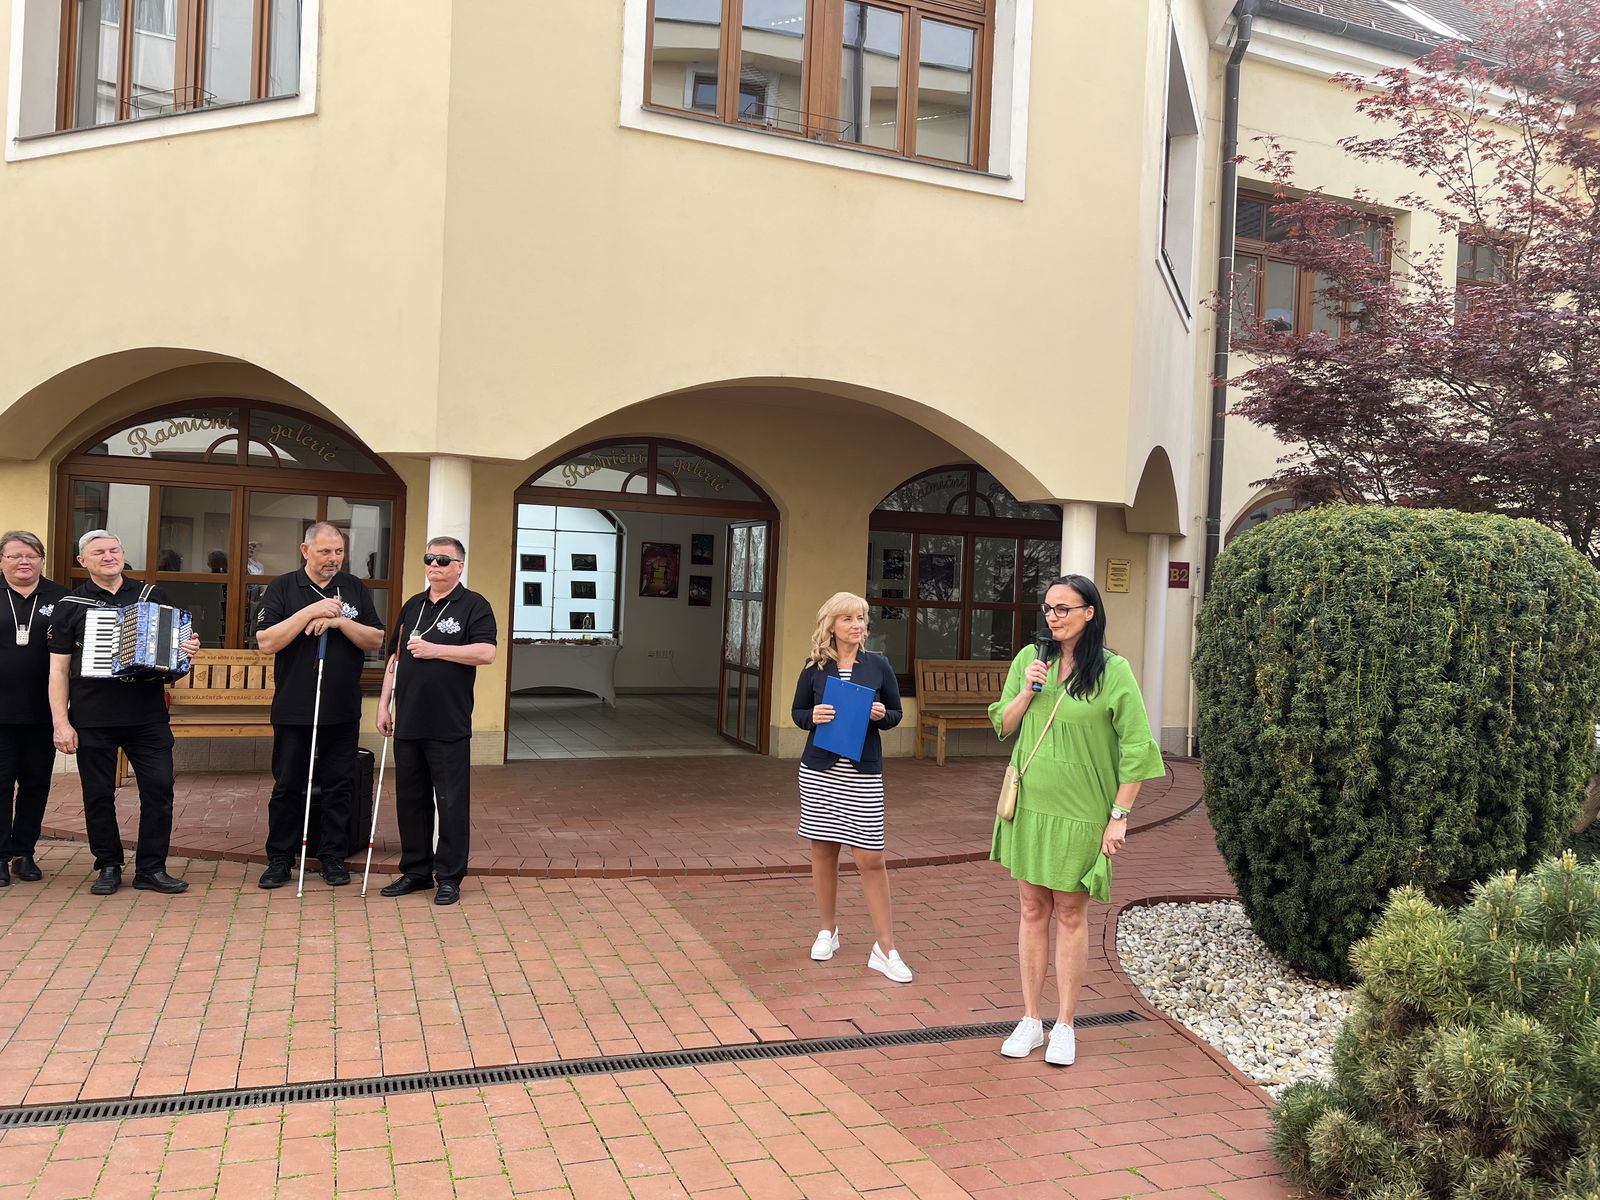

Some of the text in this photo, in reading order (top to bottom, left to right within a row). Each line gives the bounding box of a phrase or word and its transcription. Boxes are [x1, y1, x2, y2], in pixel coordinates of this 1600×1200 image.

[127, 411, 335, 462] Radniční galerie
[562, 448, 727, 492] Radniční galerie
[1170, 568, 1188, 582] B2
